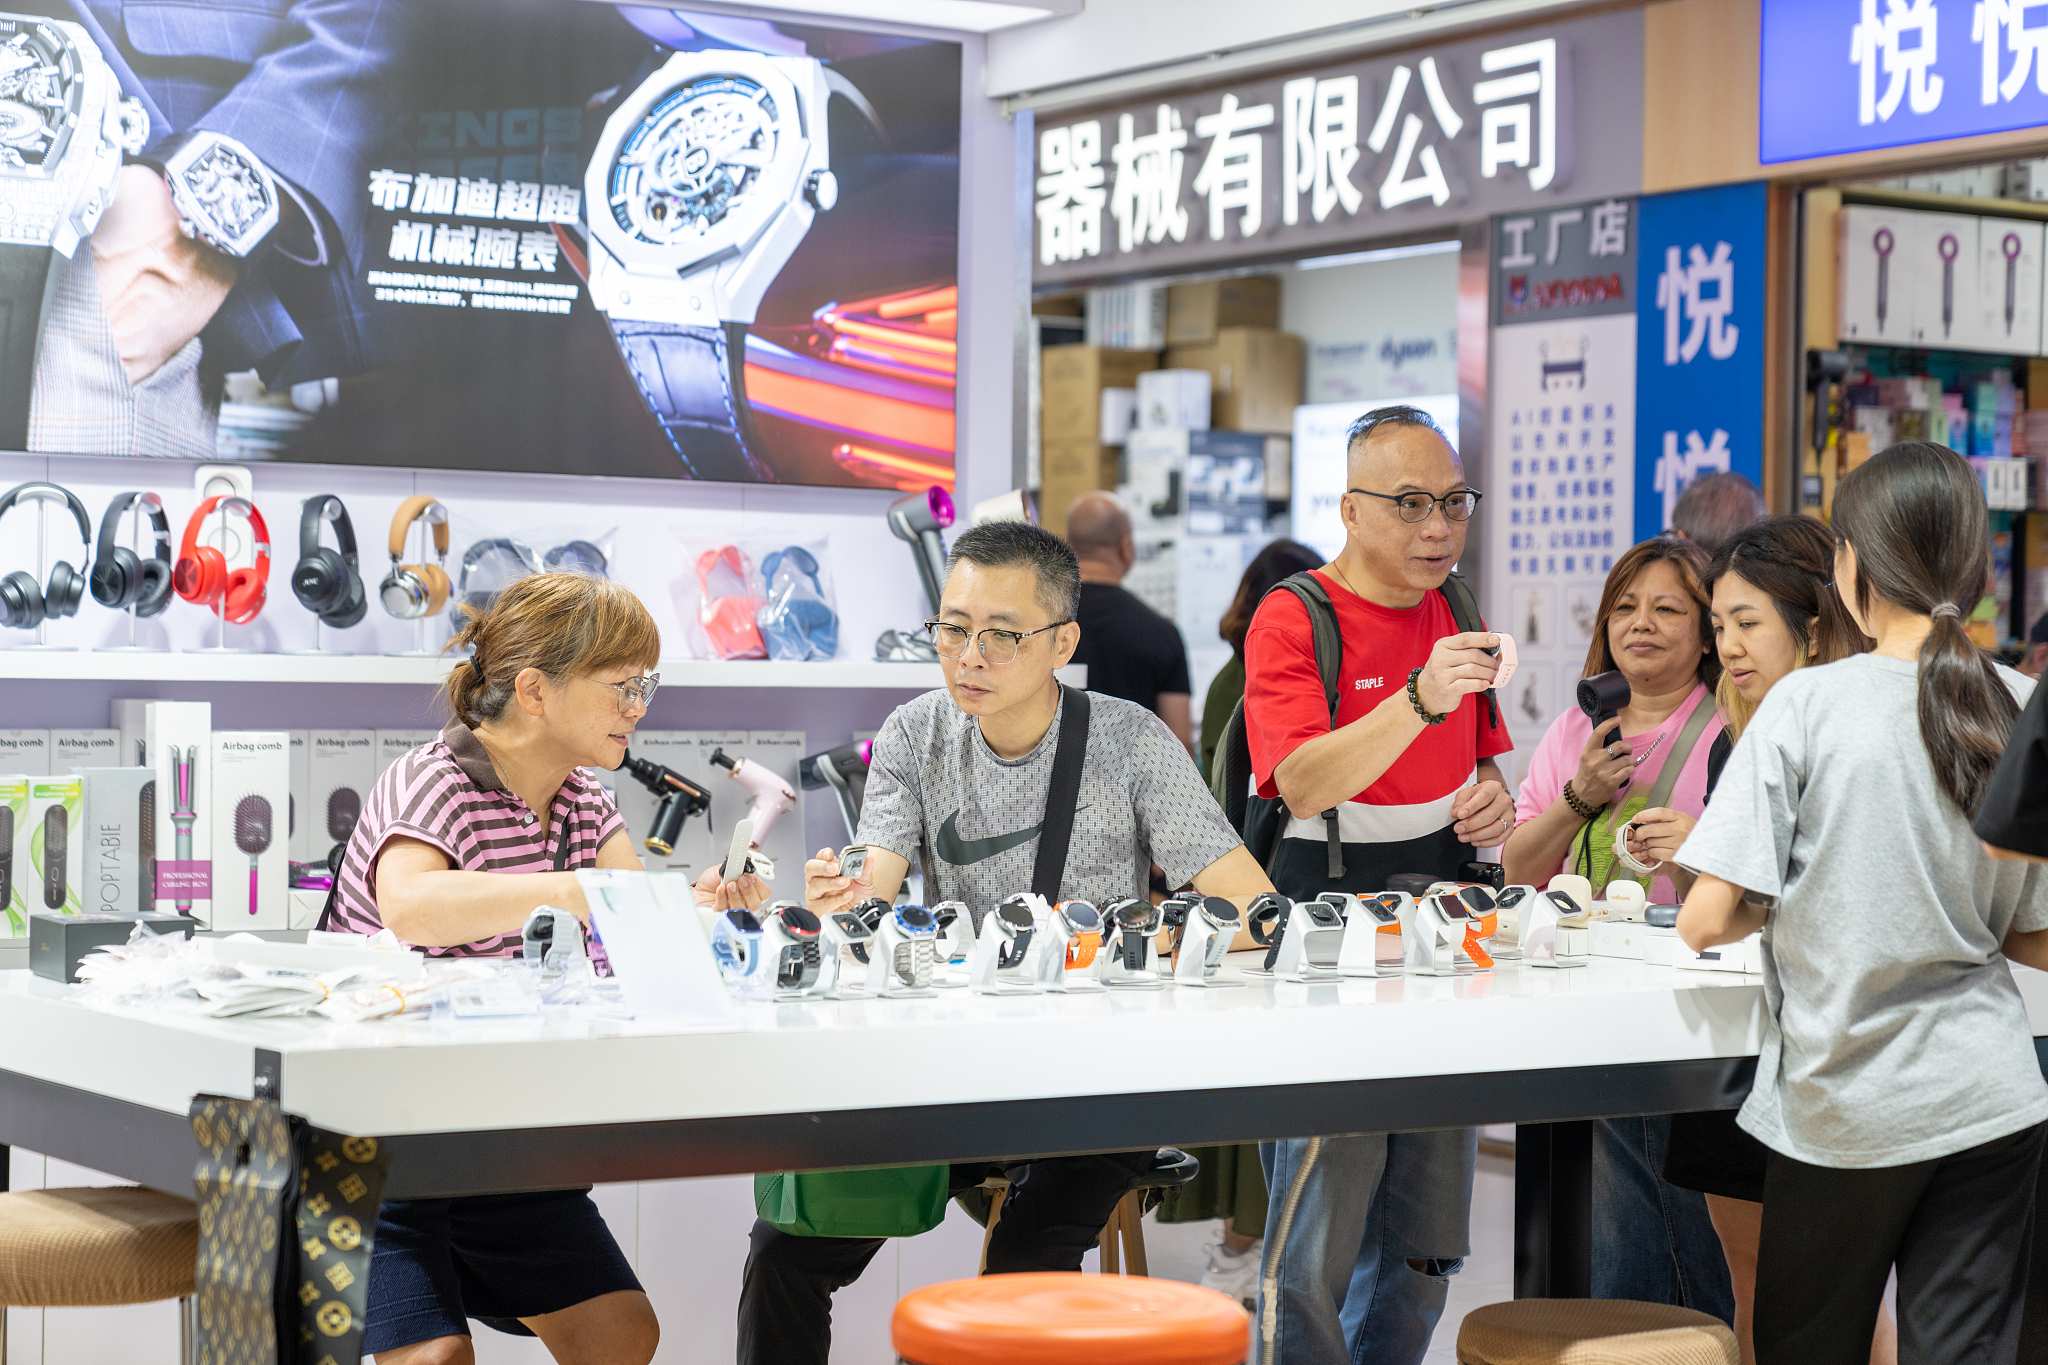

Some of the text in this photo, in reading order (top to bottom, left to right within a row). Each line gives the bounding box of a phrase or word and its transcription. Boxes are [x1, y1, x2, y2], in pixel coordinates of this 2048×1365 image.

[1036, 38, 1557, 266] 器械有限公司
[368, 168, 582, 226] 布加迪超跑
[1501, 199, 1628, 268] 工厂店
[388, 219, 558, 273] 机械腕表
[1355, 676, 1385, 690] STAPLE
[0, 738, 44, 750] bag comb
[58, 738, 115, 749] Airbag comb
[222, 742, 282, 753] Airbag comb
[290, 738, 303, 747] mb
[316, 738, 370, 748] Airbag comb
[383, 738, 412, 749] Airbag
[162, 871, 208, 880] PROFESSIONAL
